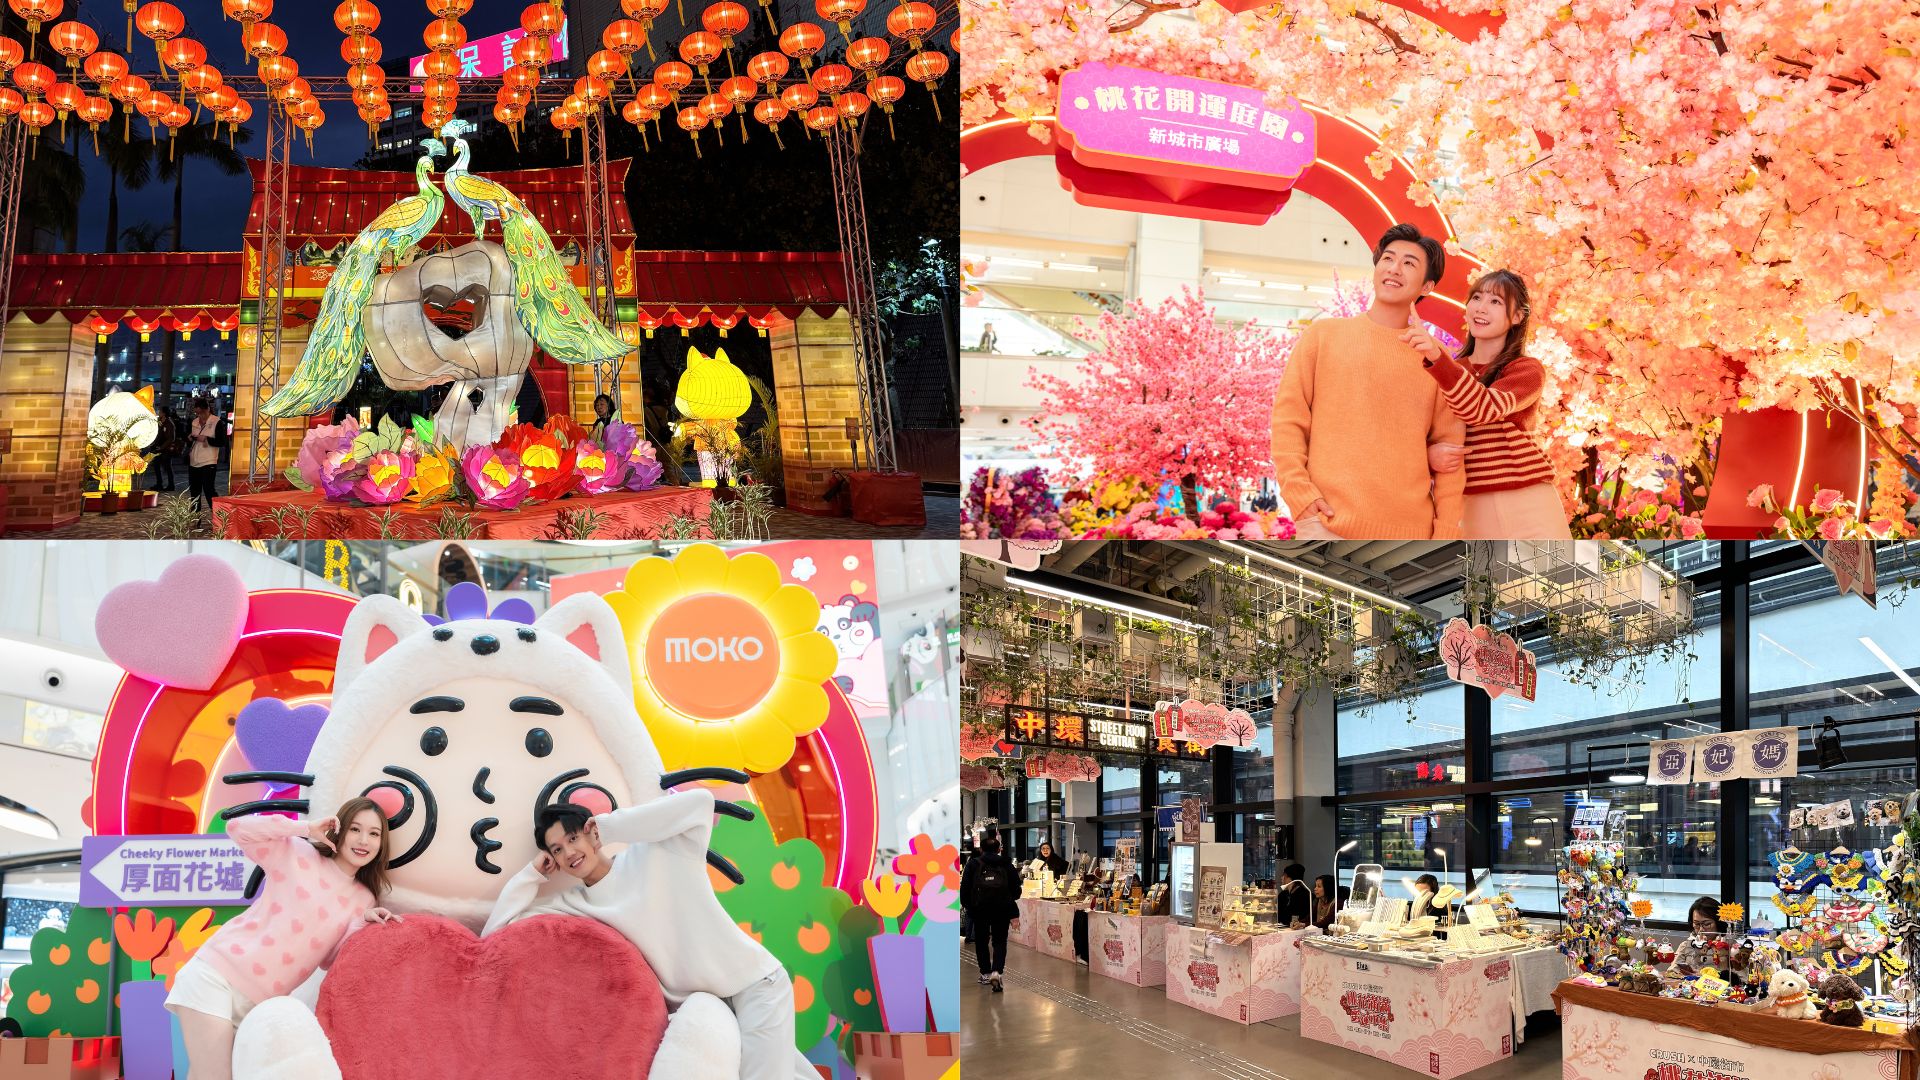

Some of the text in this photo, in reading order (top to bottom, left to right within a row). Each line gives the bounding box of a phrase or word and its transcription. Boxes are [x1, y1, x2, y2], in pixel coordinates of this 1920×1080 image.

[1094, 85, 1290, 141] 桃花開運庭園
[1148, 127, 1241, 156] 新城市廣場
[664, 636, 764, 663] MOKO
[1013, 710, 1085, 743] 中環
[1089, 718, 1123, 735] STREET
[1125, 724, 1147, 739] FOOD
[1099, 732, 1138, 749] CENTRAL
[119, 846, 245, 861] Cheeky Flower Marke
[120, 861, 245, 893] 厚面花墟
[1648, 1048, 1686, 1064] CRUSH
